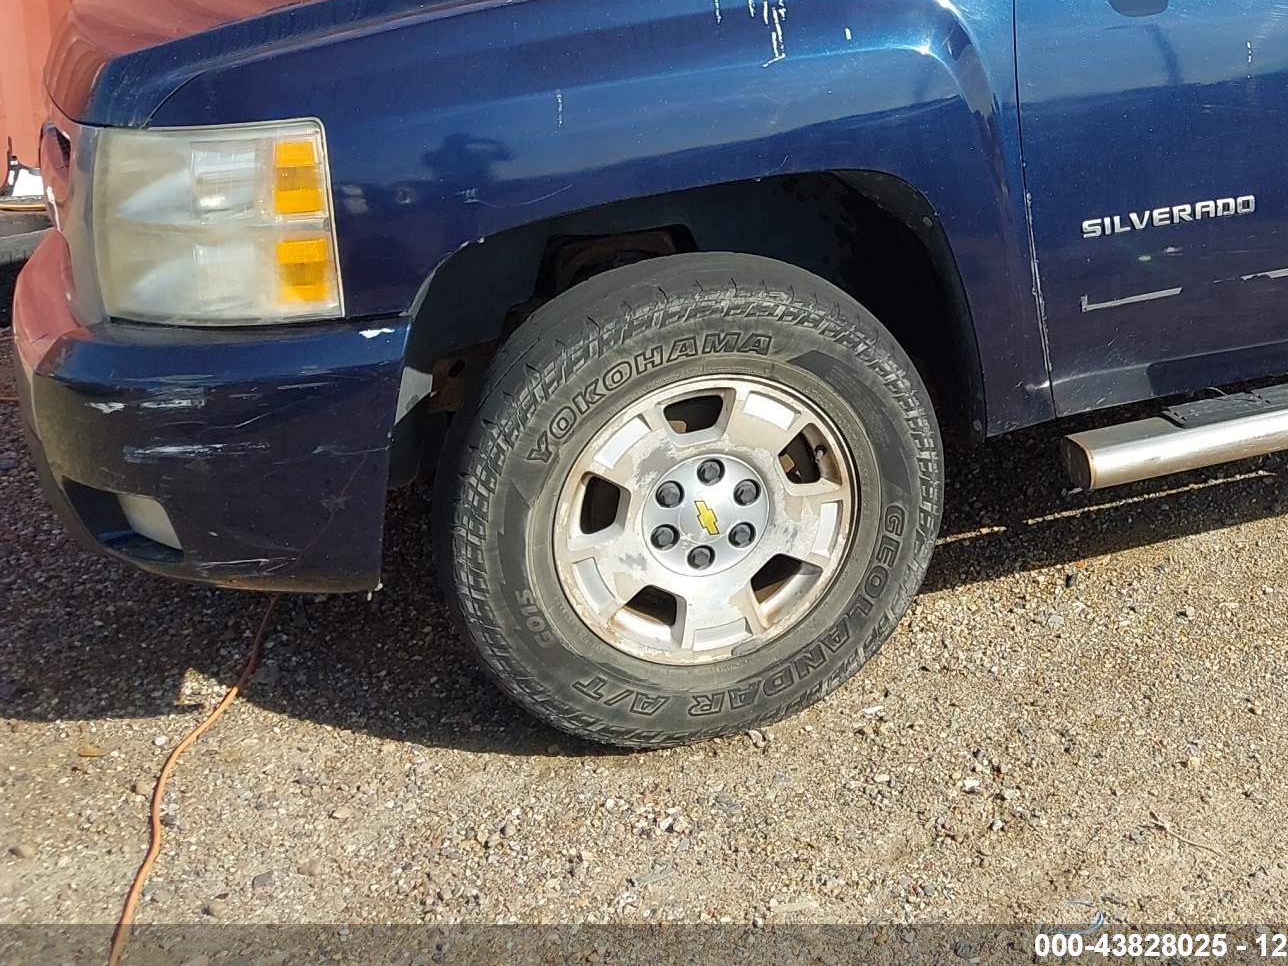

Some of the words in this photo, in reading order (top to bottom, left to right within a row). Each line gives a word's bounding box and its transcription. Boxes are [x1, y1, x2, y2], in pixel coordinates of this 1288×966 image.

[1081, 194, 1256, 239] SILVERADO
[527, 332, 773, 464] YOKOHAMA
[687, 501, 907, 717] GEOLANDAR
[573, 675, 673, 716] A/T
